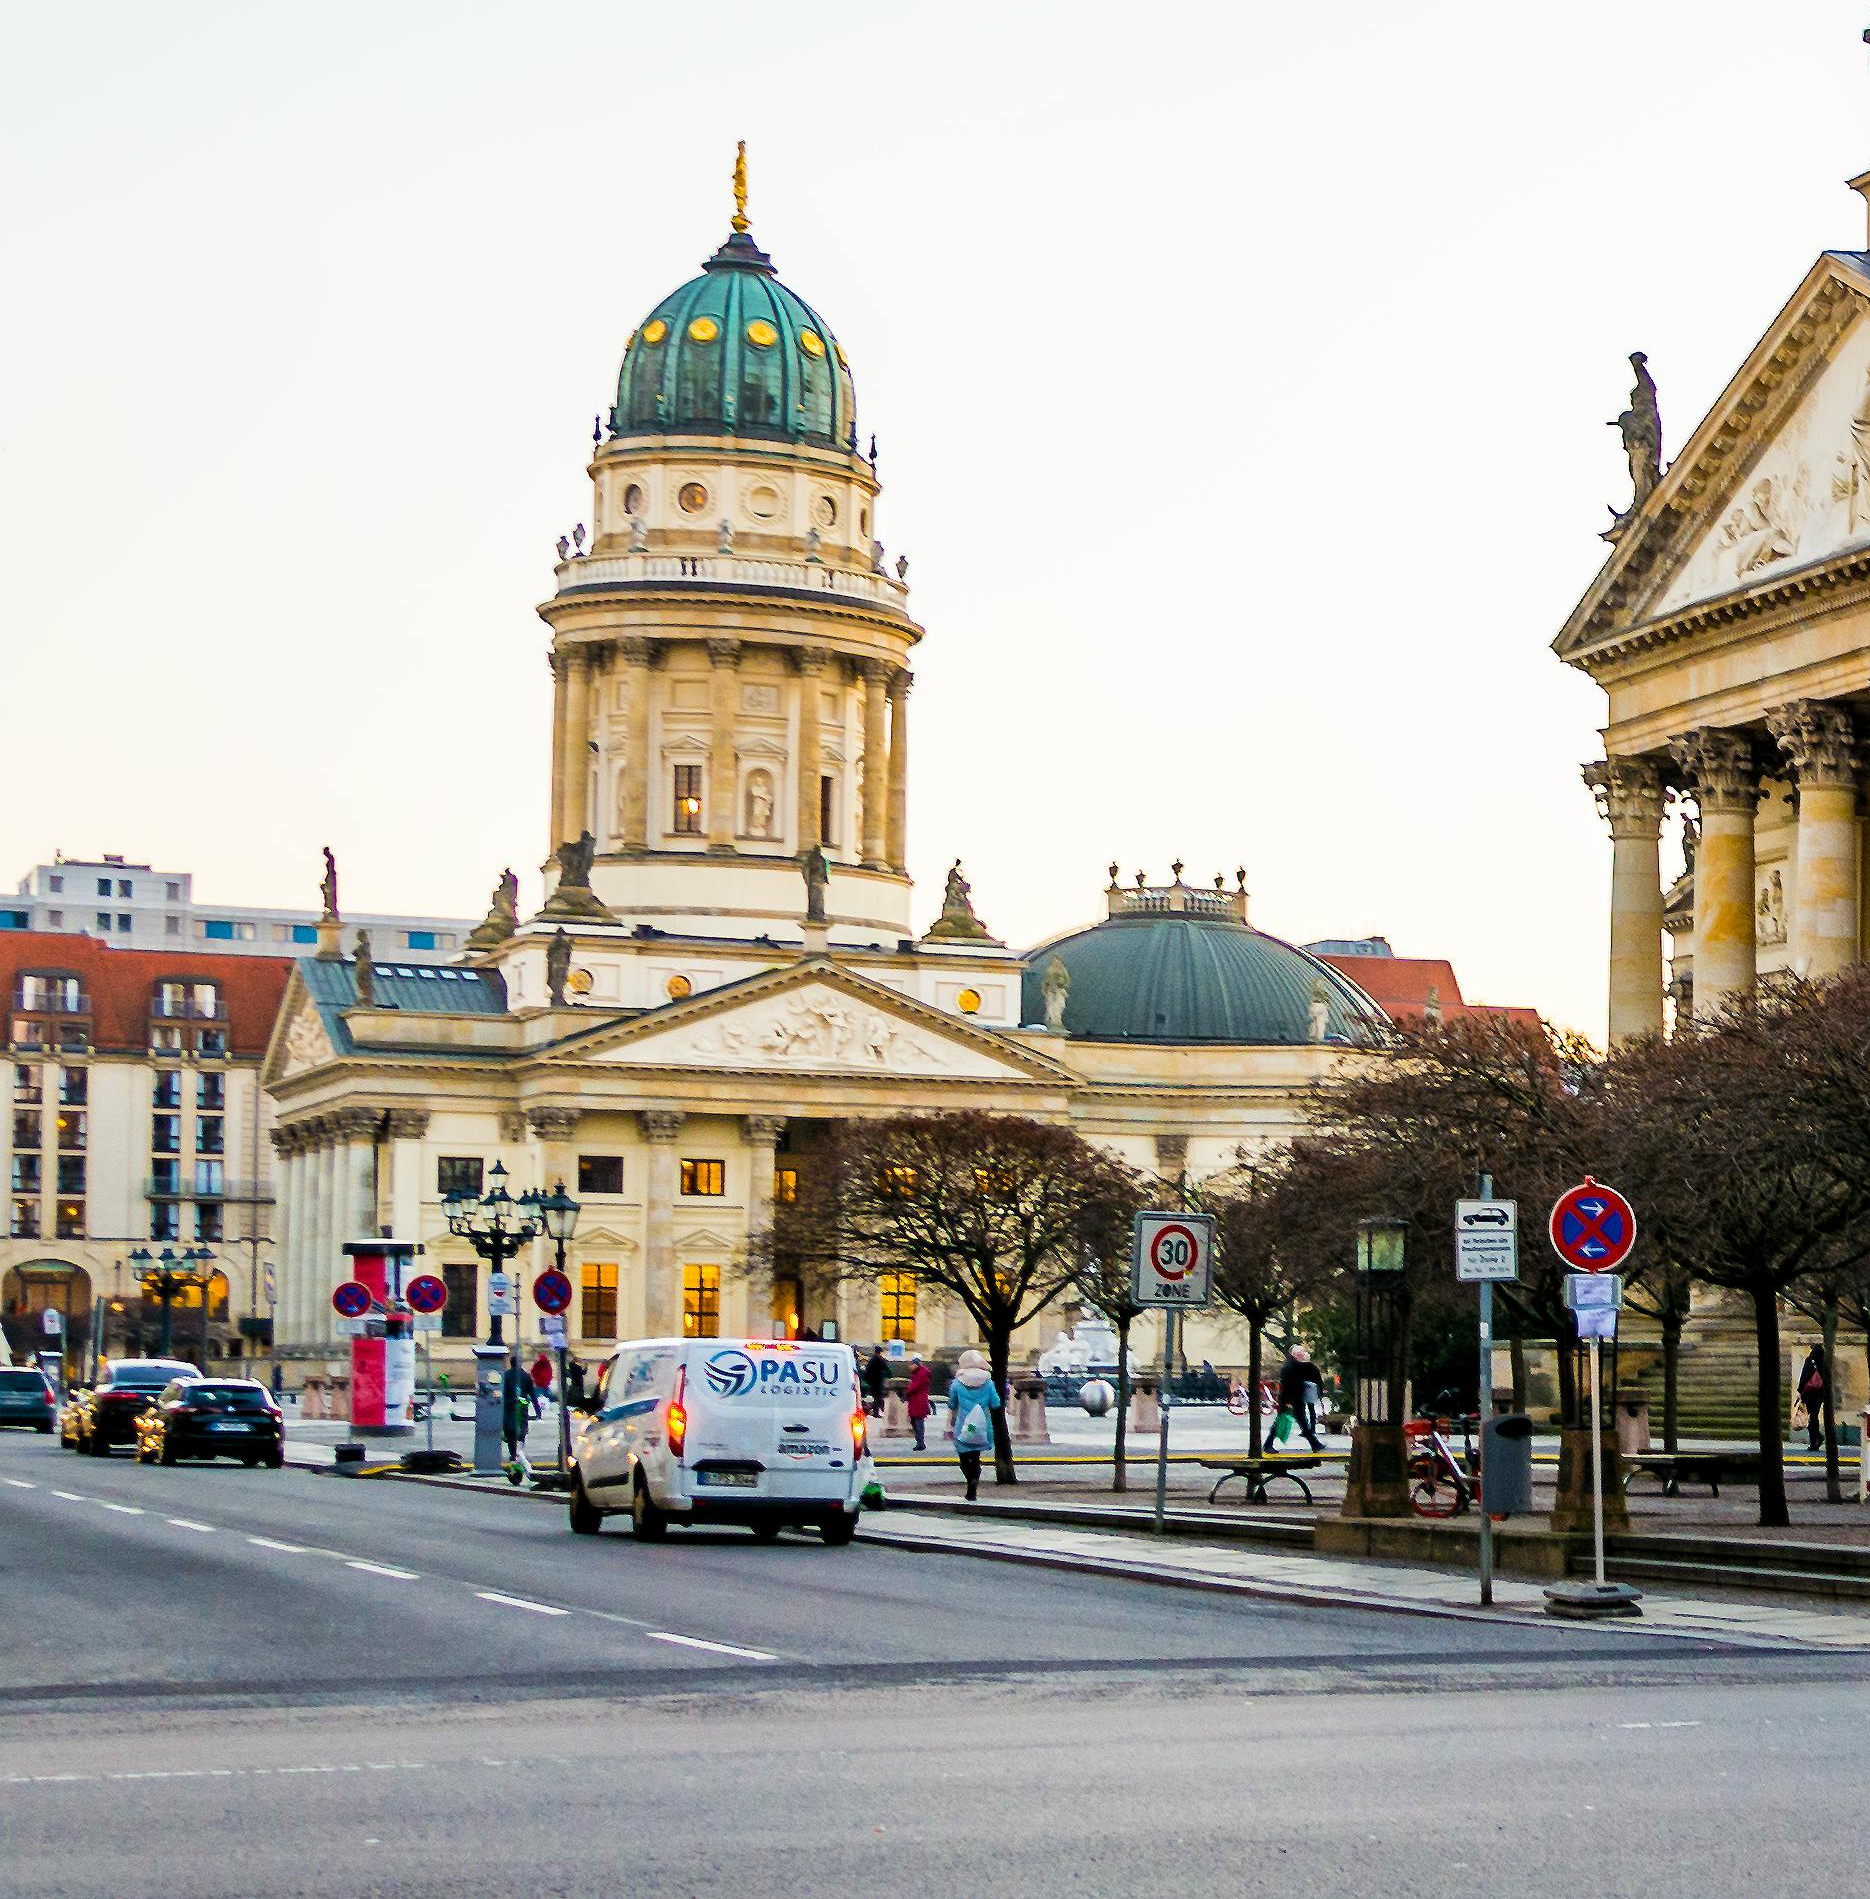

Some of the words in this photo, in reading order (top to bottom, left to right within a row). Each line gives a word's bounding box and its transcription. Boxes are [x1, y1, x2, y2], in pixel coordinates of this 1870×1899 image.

[1160, 1239, 1188, 1266] 30
[1154, 1283, 1190, 1298] ZONE
[760, 1359, 839, 1385] PASU
[760, 1385, 839, 1397] LOGISTIC
[778, 1443, 831, 1455] amazon
